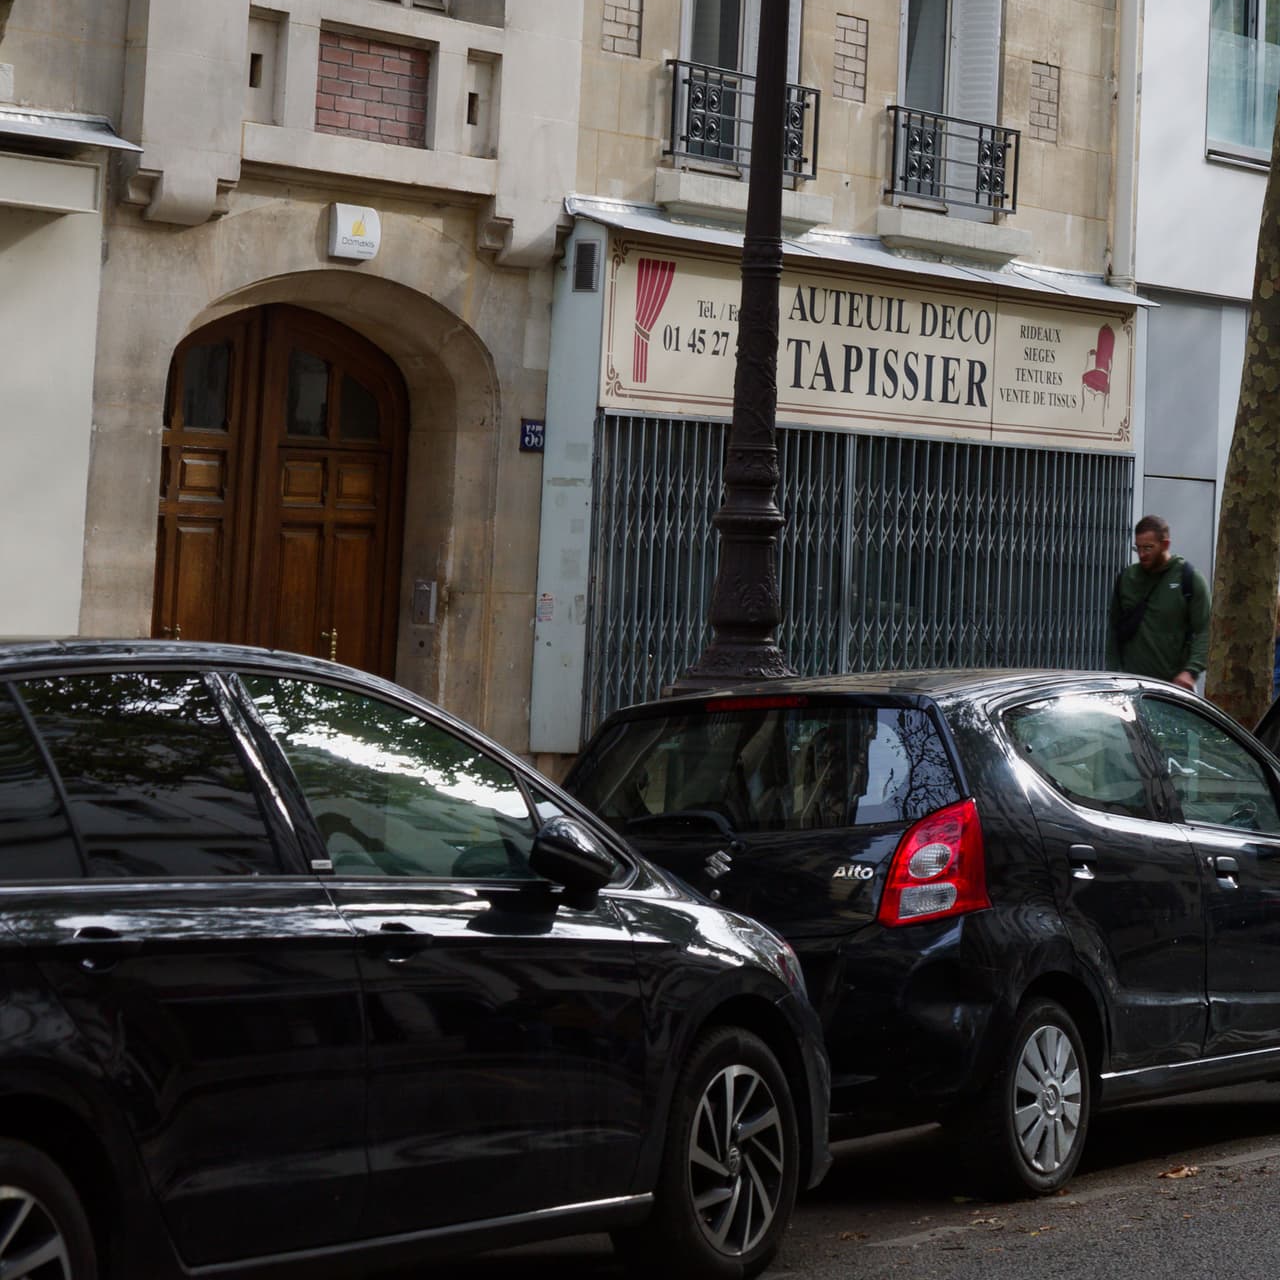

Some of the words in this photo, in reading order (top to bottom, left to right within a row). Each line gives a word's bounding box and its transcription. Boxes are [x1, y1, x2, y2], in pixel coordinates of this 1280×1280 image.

[697, 300, 717, 319] Tél.
[788, 283, 911, 334] AUTEUIL
[920, 301, 992, 345] DECO
[663, 324, 681, 352] 01
[687, 327, 706, 355] 45
[711, 330, 730, 357] 27
[1020, 324, 1061, 343] RIDEAUX
[1024, 347, 1056, 363] SIEGES
[787, 337, 988, 407] TAPISSIER
[1016, 367, 1063, 386] TENTURES
[1000, 387, 1030, 404] VENTE
[1033, 391, 1046, 406] DE
[1048, 392, 1077, 409] TISSUS
[524, 423, 544, 448] 53
[833, 864, 874, 880] Alto
